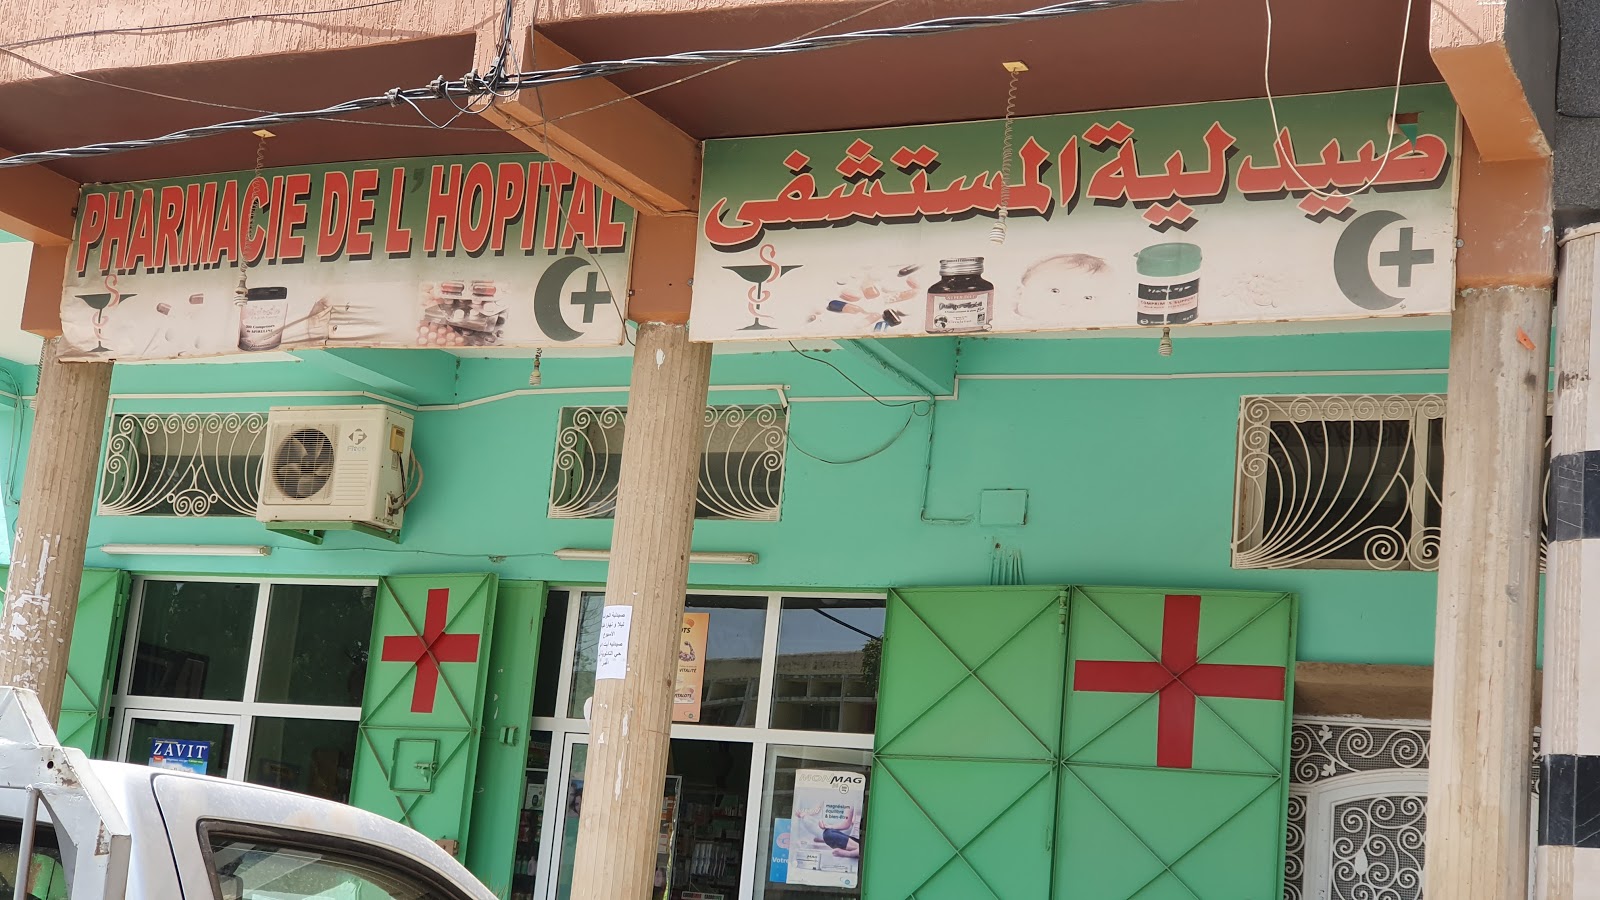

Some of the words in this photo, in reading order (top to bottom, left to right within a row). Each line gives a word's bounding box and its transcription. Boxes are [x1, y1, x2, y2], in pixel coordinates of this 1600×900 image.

[76, 174, 312, 275] PHARMACIE
[316, 169, 379, 261] DE
[704, 135, 1080, 250] المستشفى
[1086, 121, 1450, 231] صيدلية
